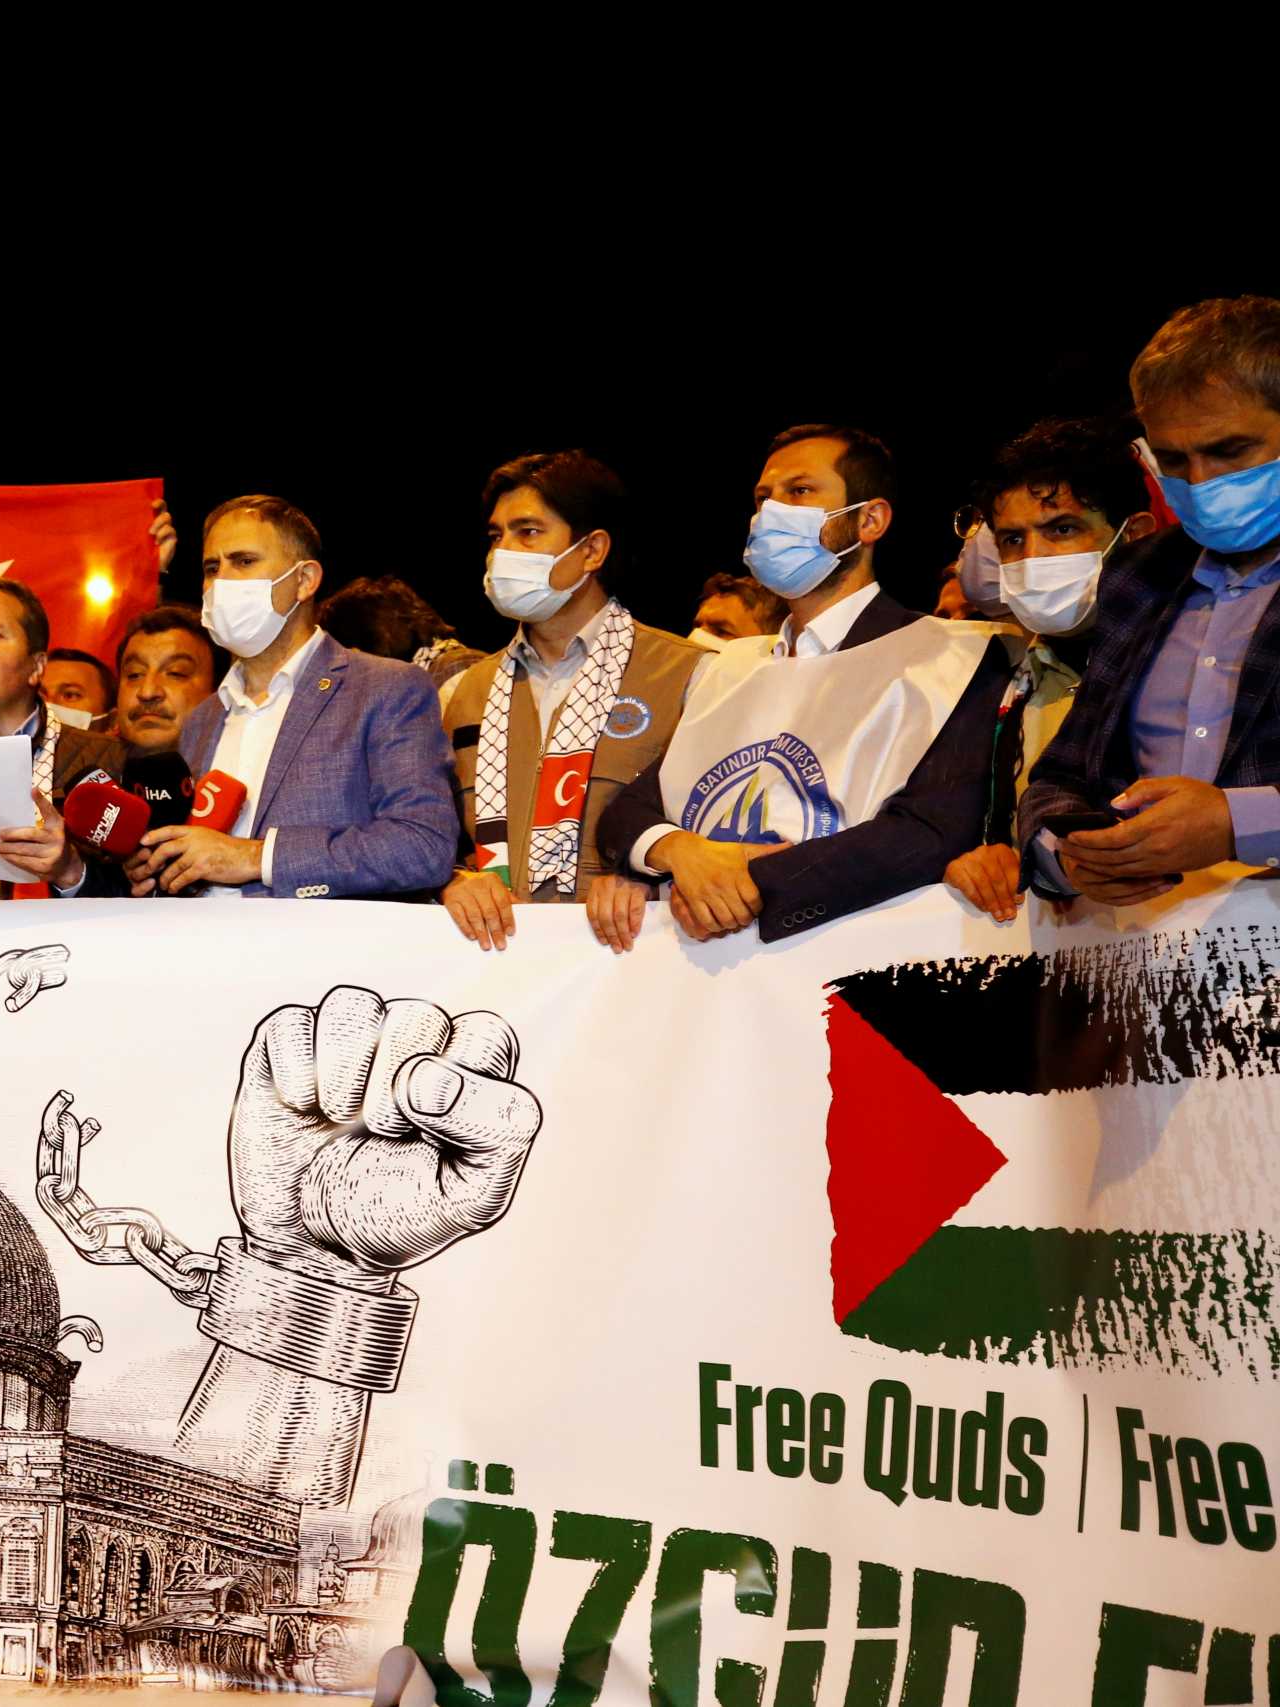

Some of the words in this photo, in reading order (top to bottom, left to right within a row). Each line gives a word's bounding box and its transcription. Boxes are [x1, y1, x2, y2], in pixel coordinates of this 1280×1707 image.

[144, 786, 172, 801] İHA
[696, 744, 767, 797] BAYINDIR
[699, 1362, 846, 1485] Free
[863, 1379, 1049, 1517] Quds
[1115, 1406, 1277, 1553] Free
